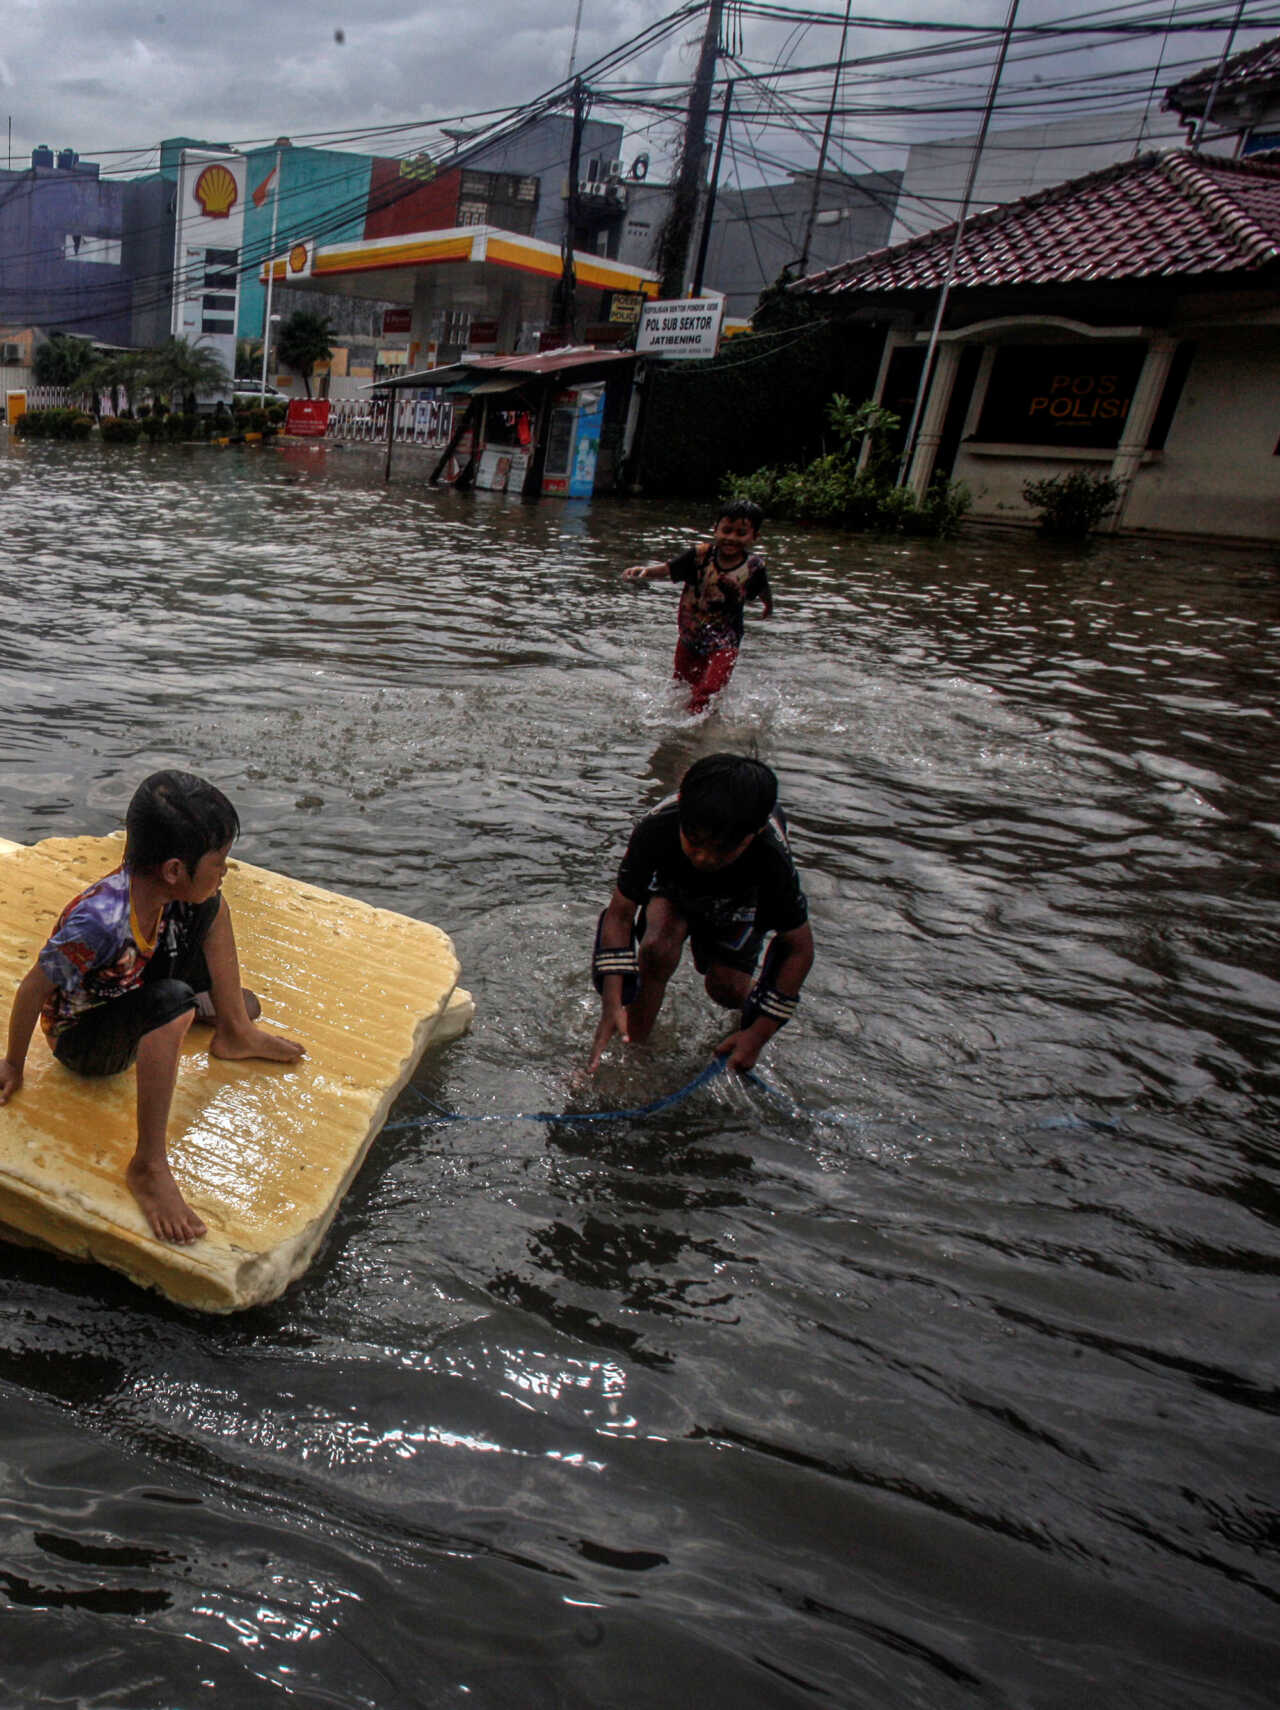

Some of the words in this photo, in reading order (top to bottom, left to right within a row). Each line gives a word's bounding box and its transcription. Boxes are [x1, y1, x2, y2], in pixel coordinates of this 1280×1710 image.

[645, 318, 660, 332] POL
[662, 317, 677, 331] SUB
[680, 316, 712, 331] SEKTOR
[649, 334, 702, 346] JATIBENING
[1049, 375, 1118, 395] POS
[1028, 396, 1129, 419] POLISI
